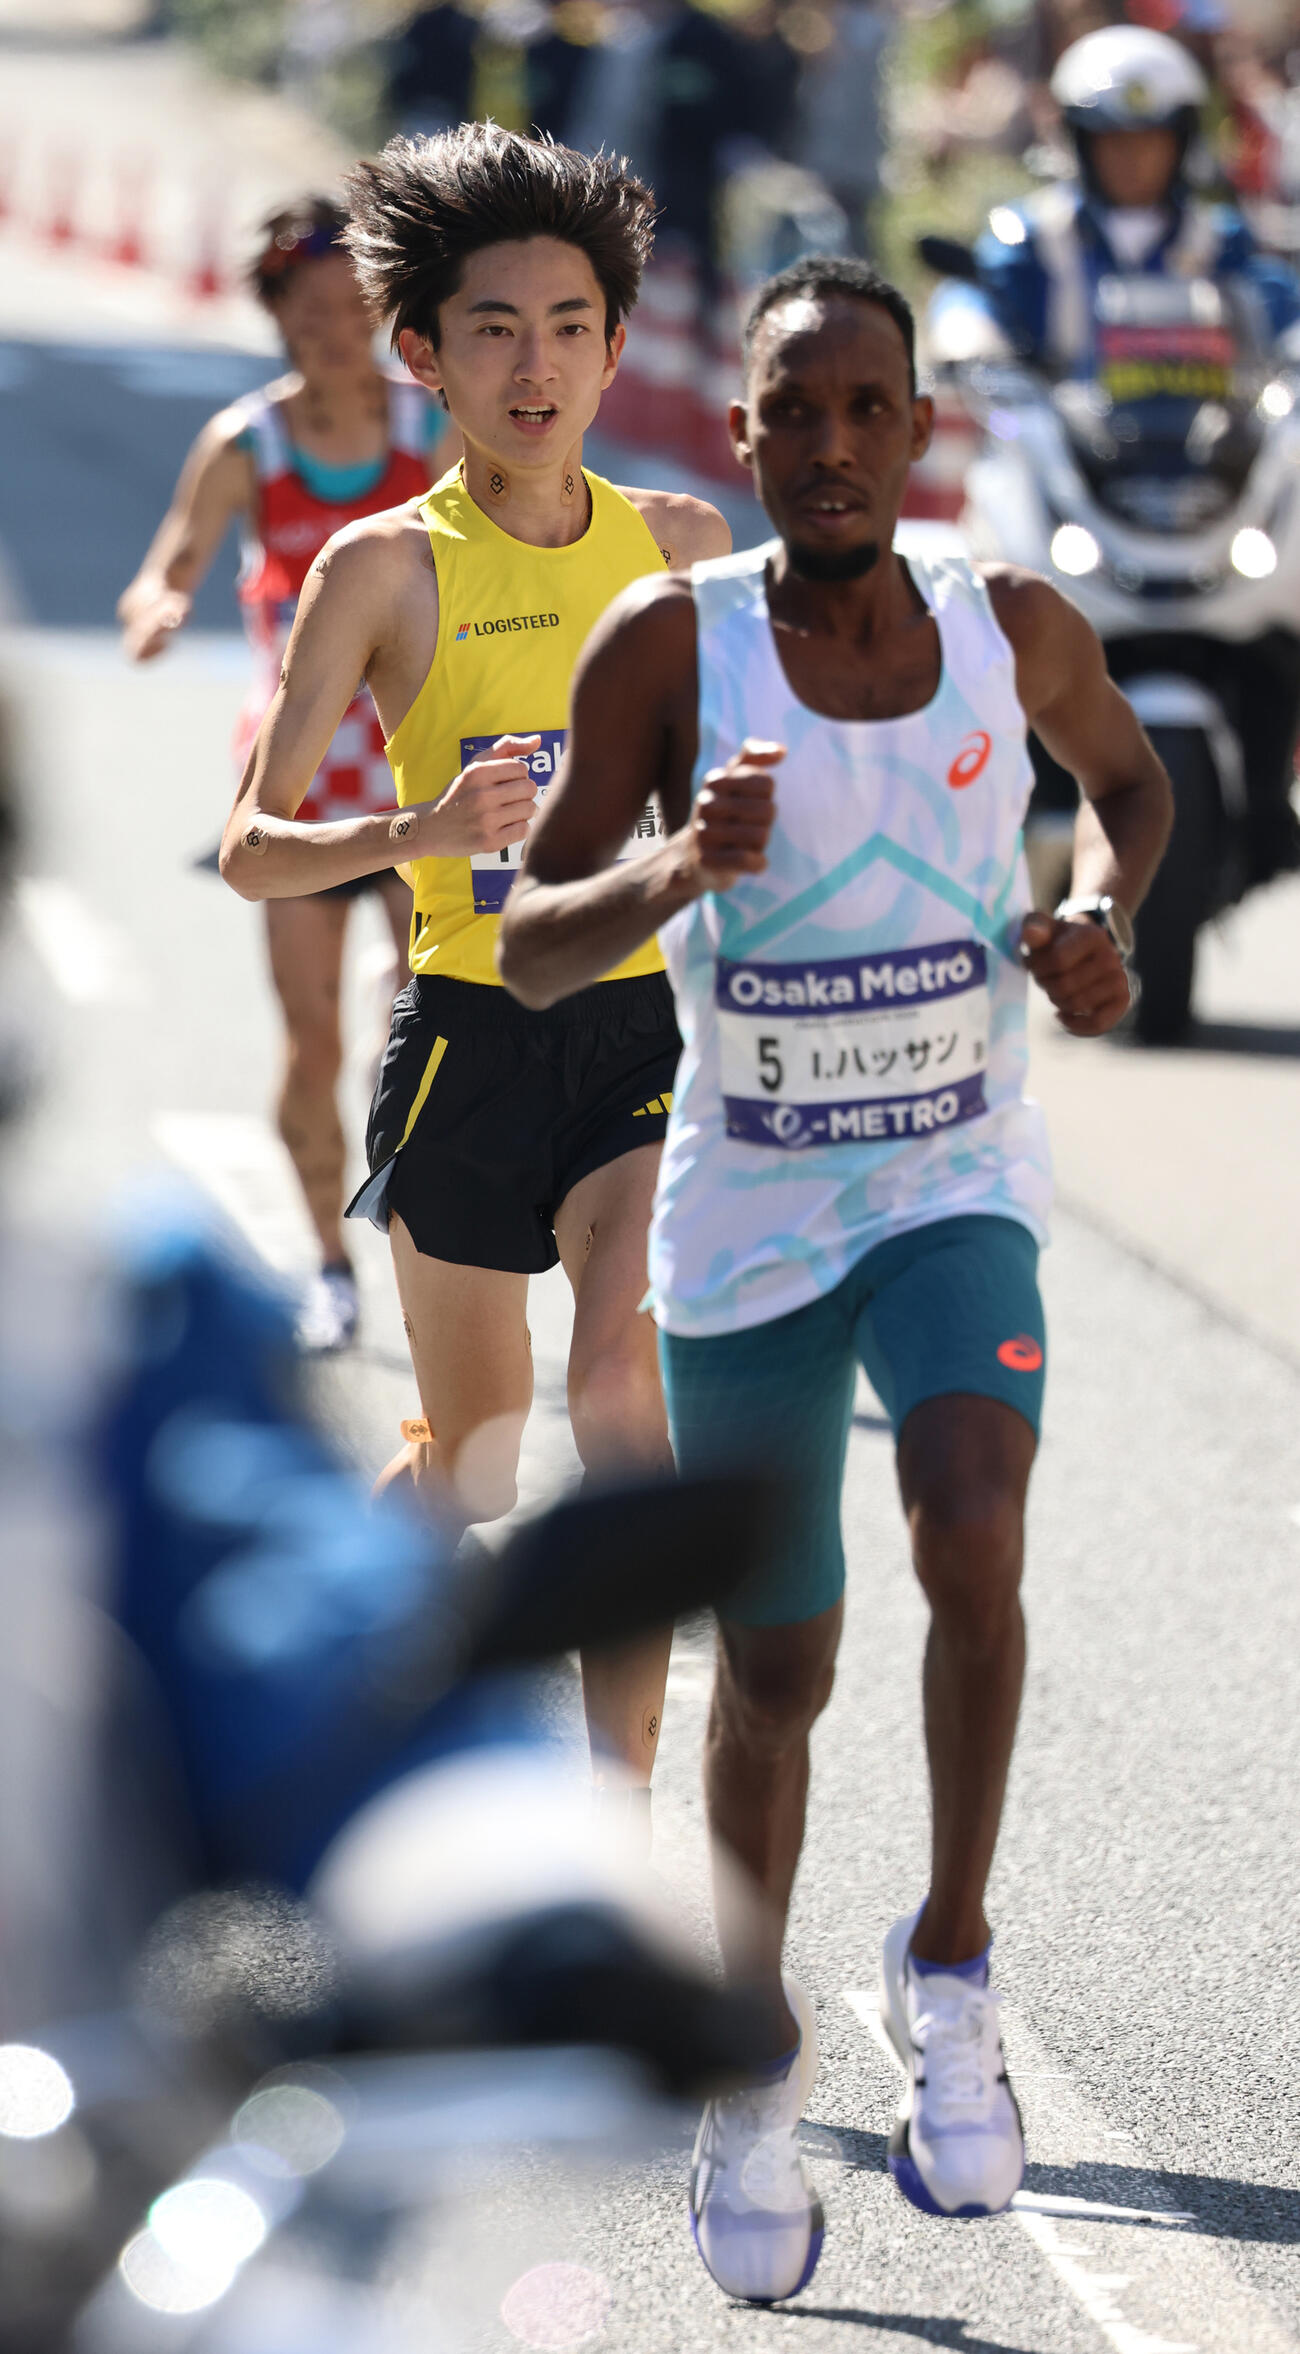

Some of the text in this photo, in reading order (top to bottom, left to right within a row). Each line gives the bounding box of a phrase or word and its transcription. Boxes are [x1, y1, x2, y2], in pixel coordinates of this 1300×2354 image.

[474, 613, 560, 636] LOGISTEED
[730, 953, 973, 1006] Osaka Metro
[758, 1036, 784, 1093] 5
